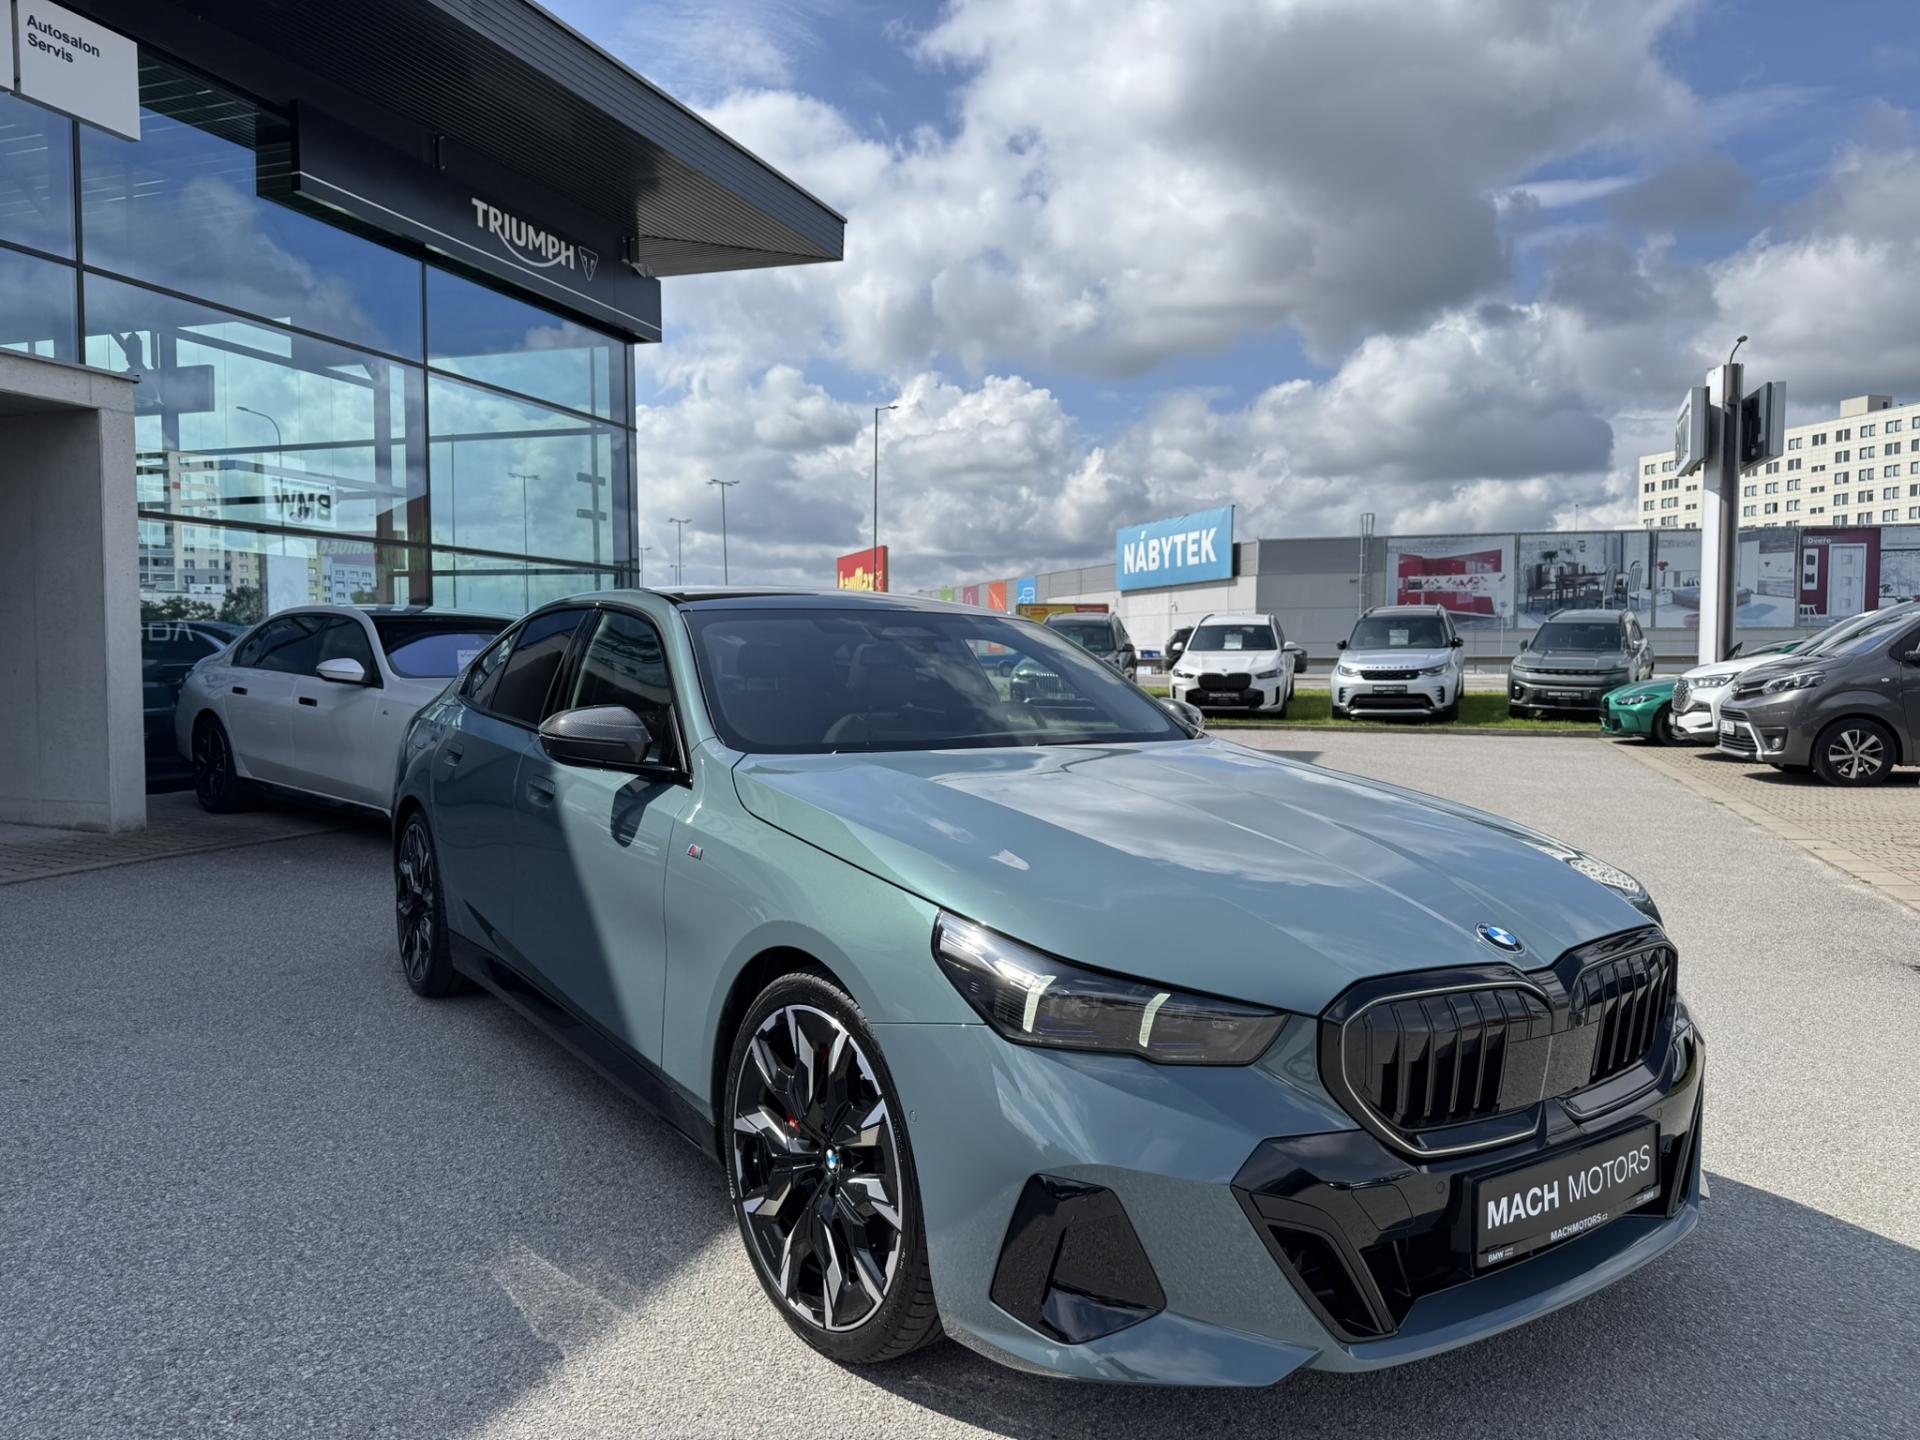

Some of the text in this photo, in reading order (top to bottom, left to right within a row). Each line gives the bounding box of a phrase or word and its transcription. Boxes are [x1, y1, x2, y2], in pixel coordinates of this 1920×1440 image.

[27, 14, 101, 58] Autosalon
[27, 32, 75, 64] Servis
[471, 197, 575, 271] TRIUMPH
[1123, 527, 1217, 575] NÁBYTEK
[1487, 1144, 1651, 1230] MACH MOTORS
[1550, 1213, 1609, 1242] MACHMOTORS.cz
[1487, 1250, 1505, 1264] BMW
